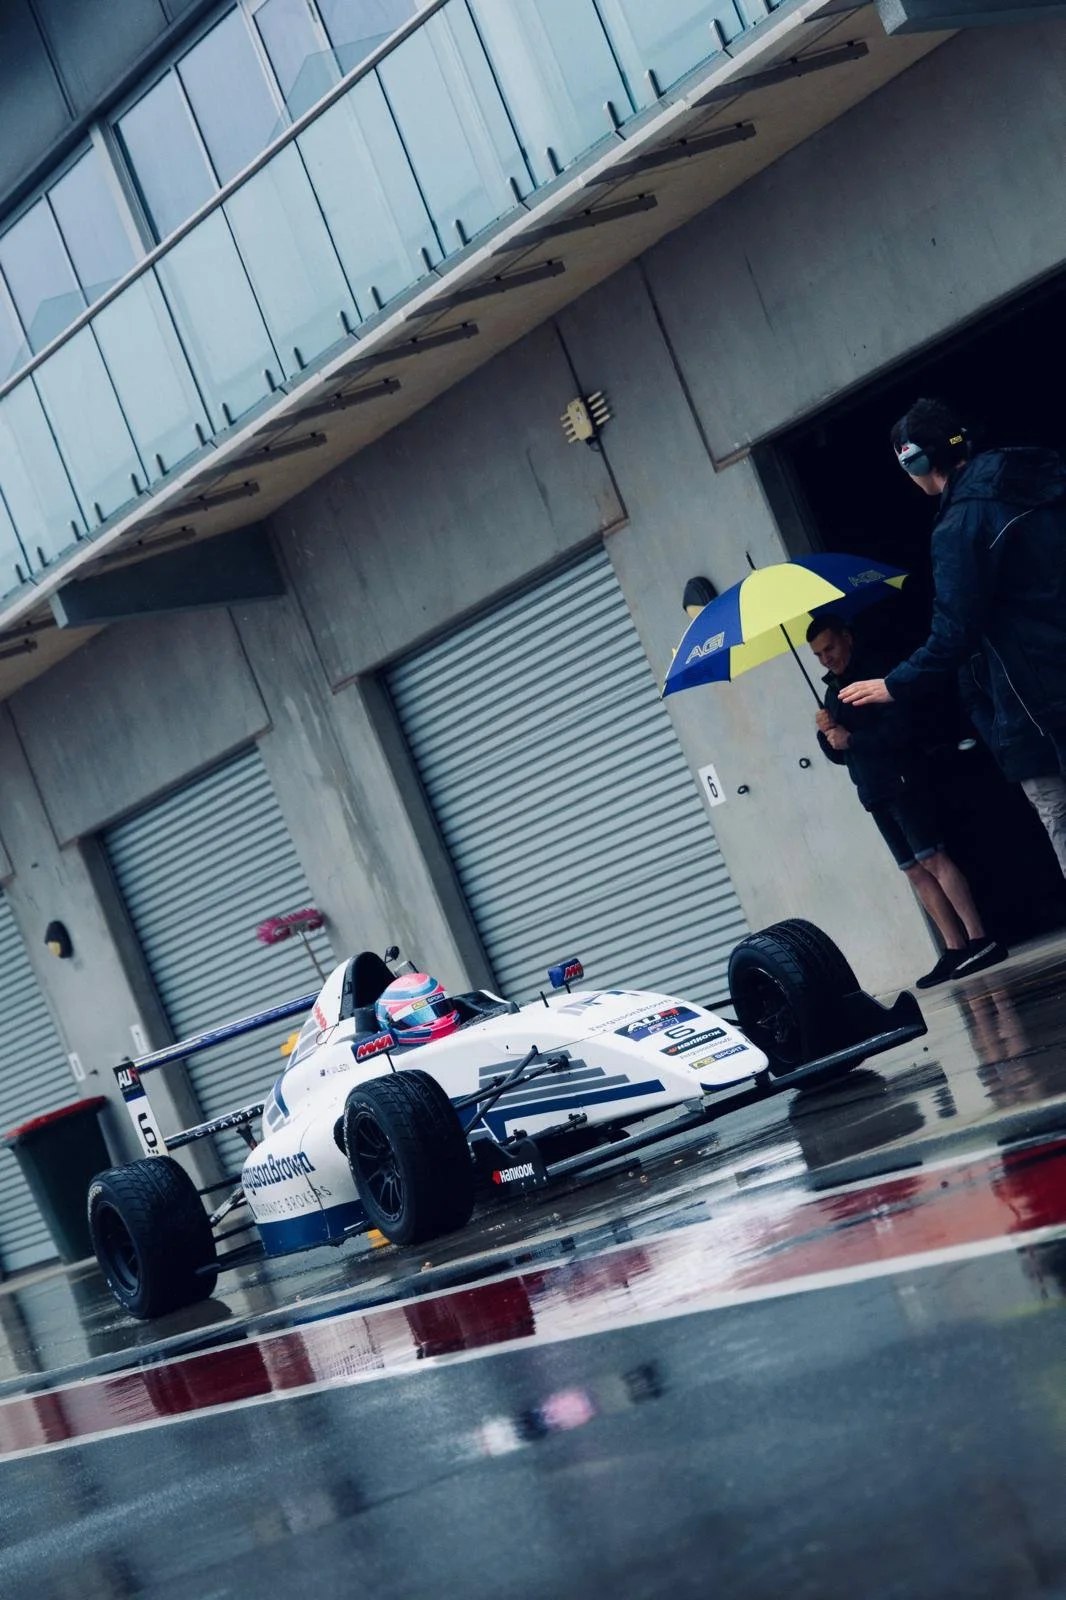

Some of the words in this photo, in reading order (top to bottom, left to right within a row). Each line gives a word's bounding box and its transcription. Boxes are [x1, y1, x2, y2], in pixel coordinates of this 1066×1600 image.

[707, 775, 718, 798] 6
[664, 1025, 696, 1039] 6
[714, 1046, 744, 1060] SPORT
[137, 1113, 157, 1148] 6
[194, 1107, 263, 1137] CHAMPI
[285, 1185, 333, 1212] BROKERS
